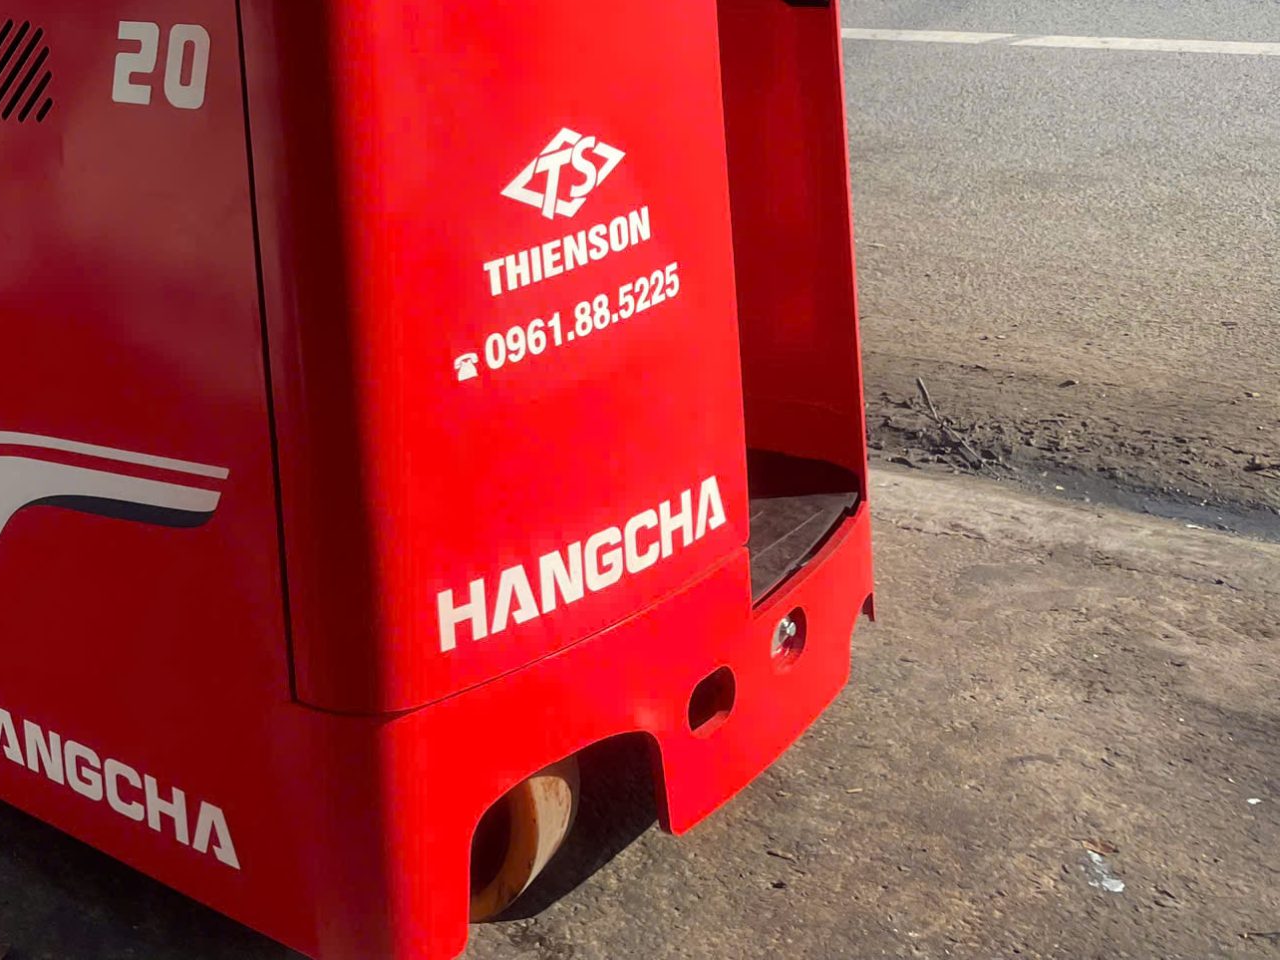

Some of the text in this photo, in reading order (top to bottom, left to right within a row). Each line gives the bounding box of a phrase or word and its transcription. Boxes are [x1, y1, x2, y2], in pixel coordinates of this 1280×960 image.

[112, 21, 210, 110] 20
[483, 205, 651, 297] THIENSON
[485, 261, 680, 371] 0961.88.5225
[437, 475, 727, 653] HANGCHA
